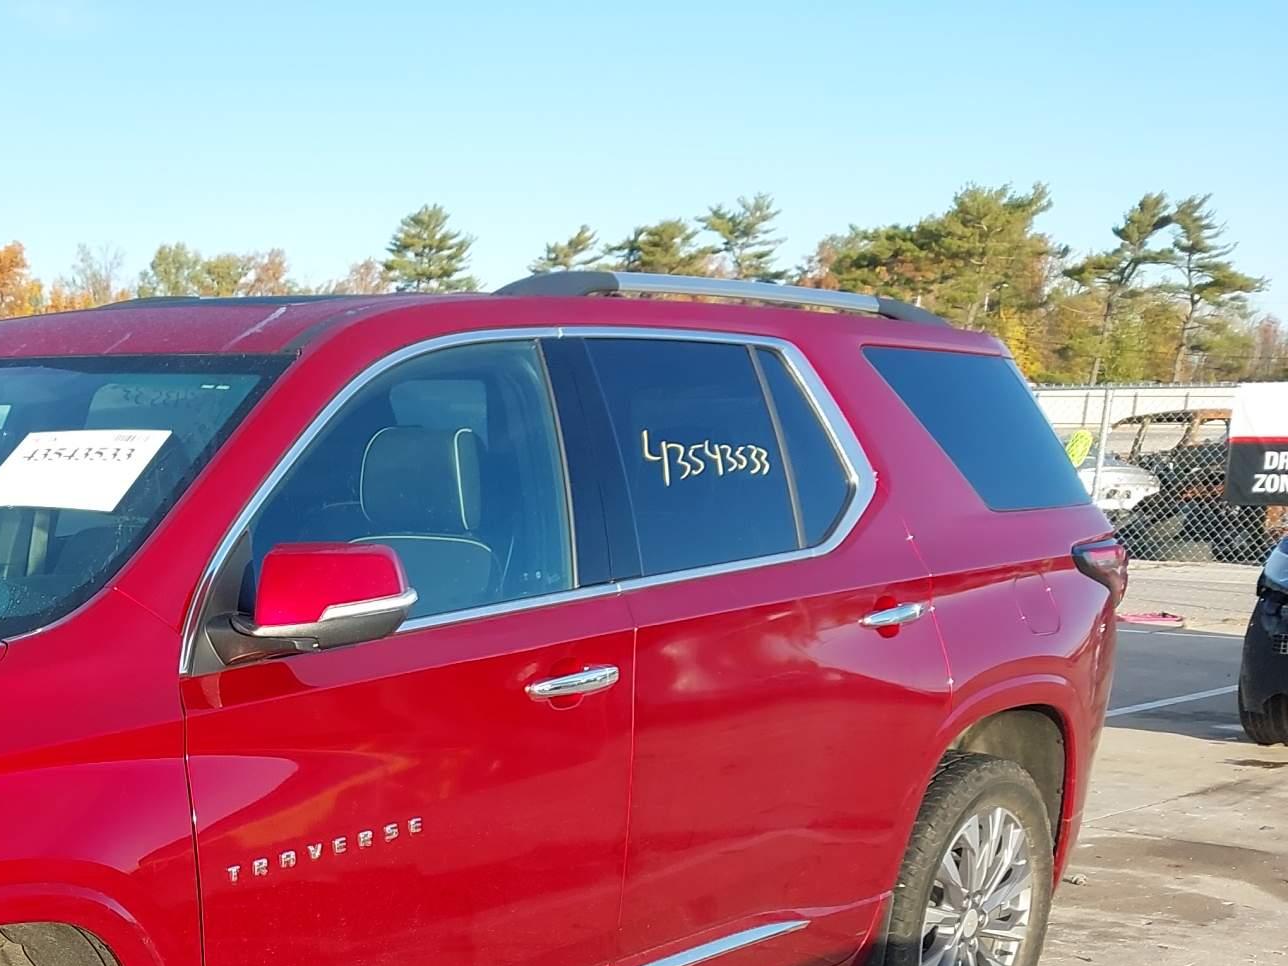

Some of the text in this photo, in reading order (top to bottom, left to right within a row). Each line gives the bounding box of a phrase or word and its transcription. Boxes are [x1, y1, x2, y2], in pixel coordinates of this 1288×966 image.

[23, 447, 136, 462] 43543533
[641, 429, 770, 487] 43543533
[226, 816, 423, 883] TRAVERSE
